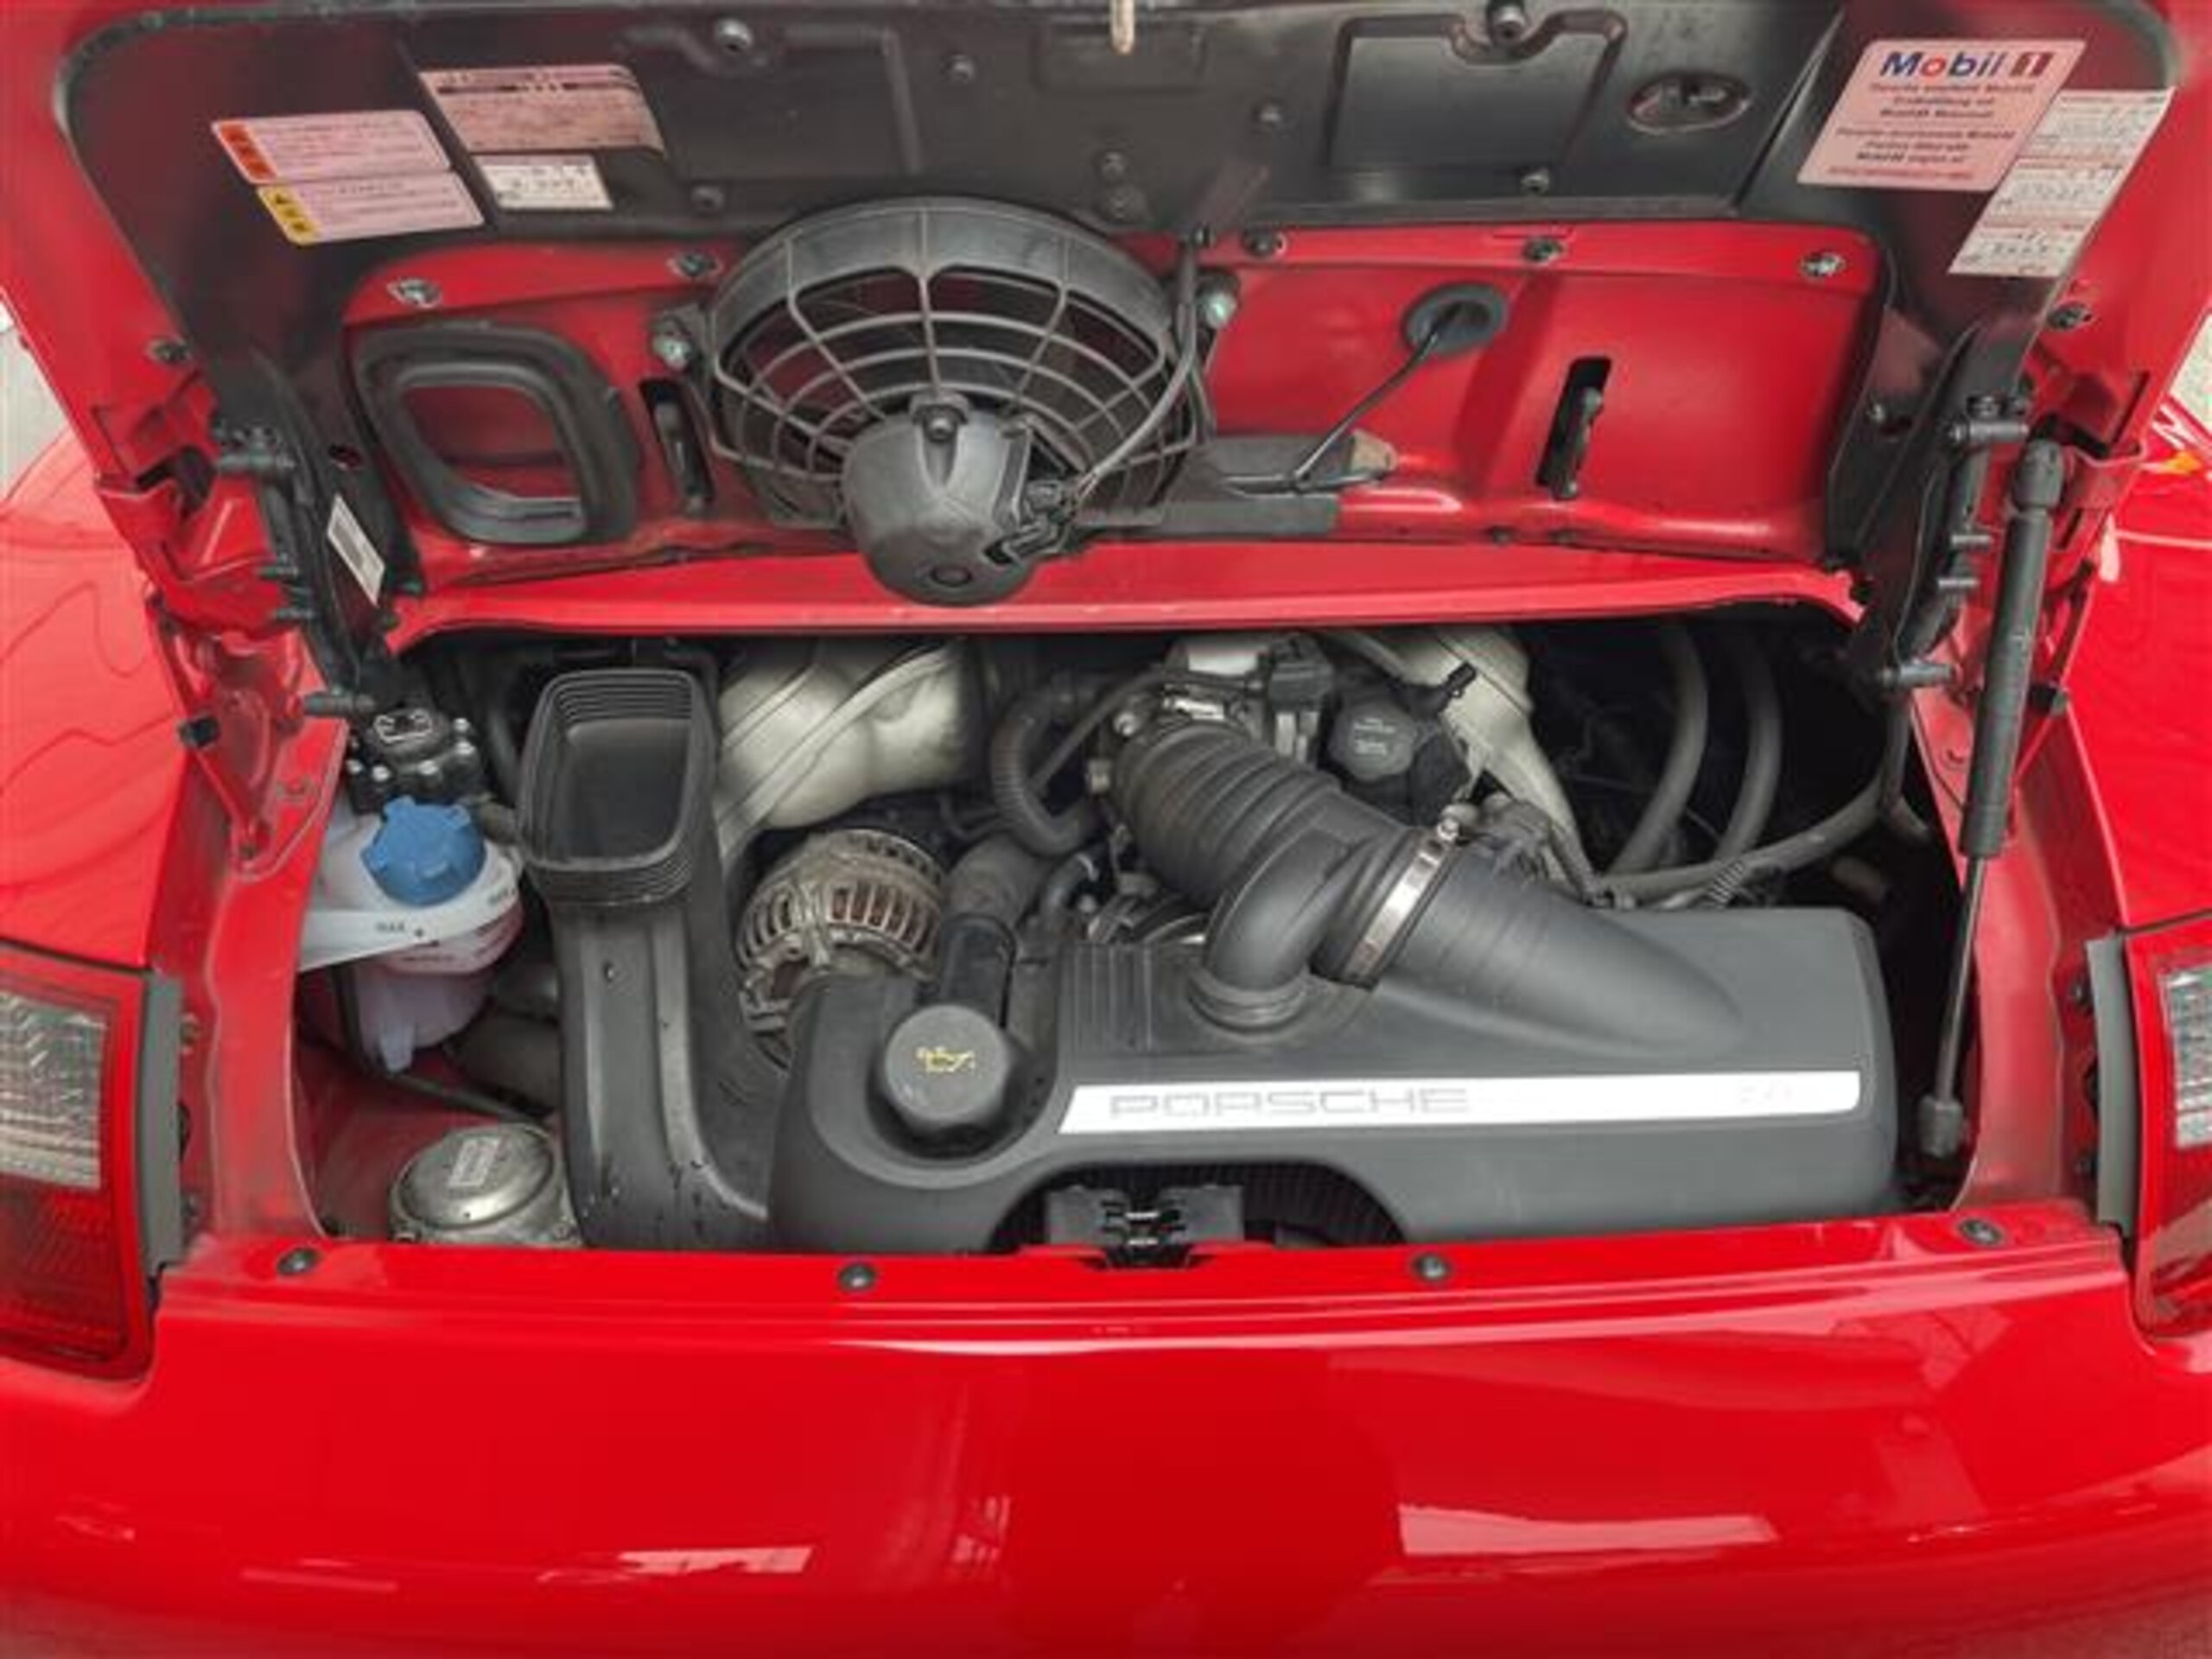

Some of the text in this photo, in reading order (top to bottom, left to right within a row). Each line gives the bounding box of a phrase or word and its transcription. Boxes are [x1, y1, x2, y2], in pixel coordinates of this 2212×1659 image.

[1879, 52, 2054, 77] Mobil 1
[1109, 1088, 1467, 1118] PORSCHE
